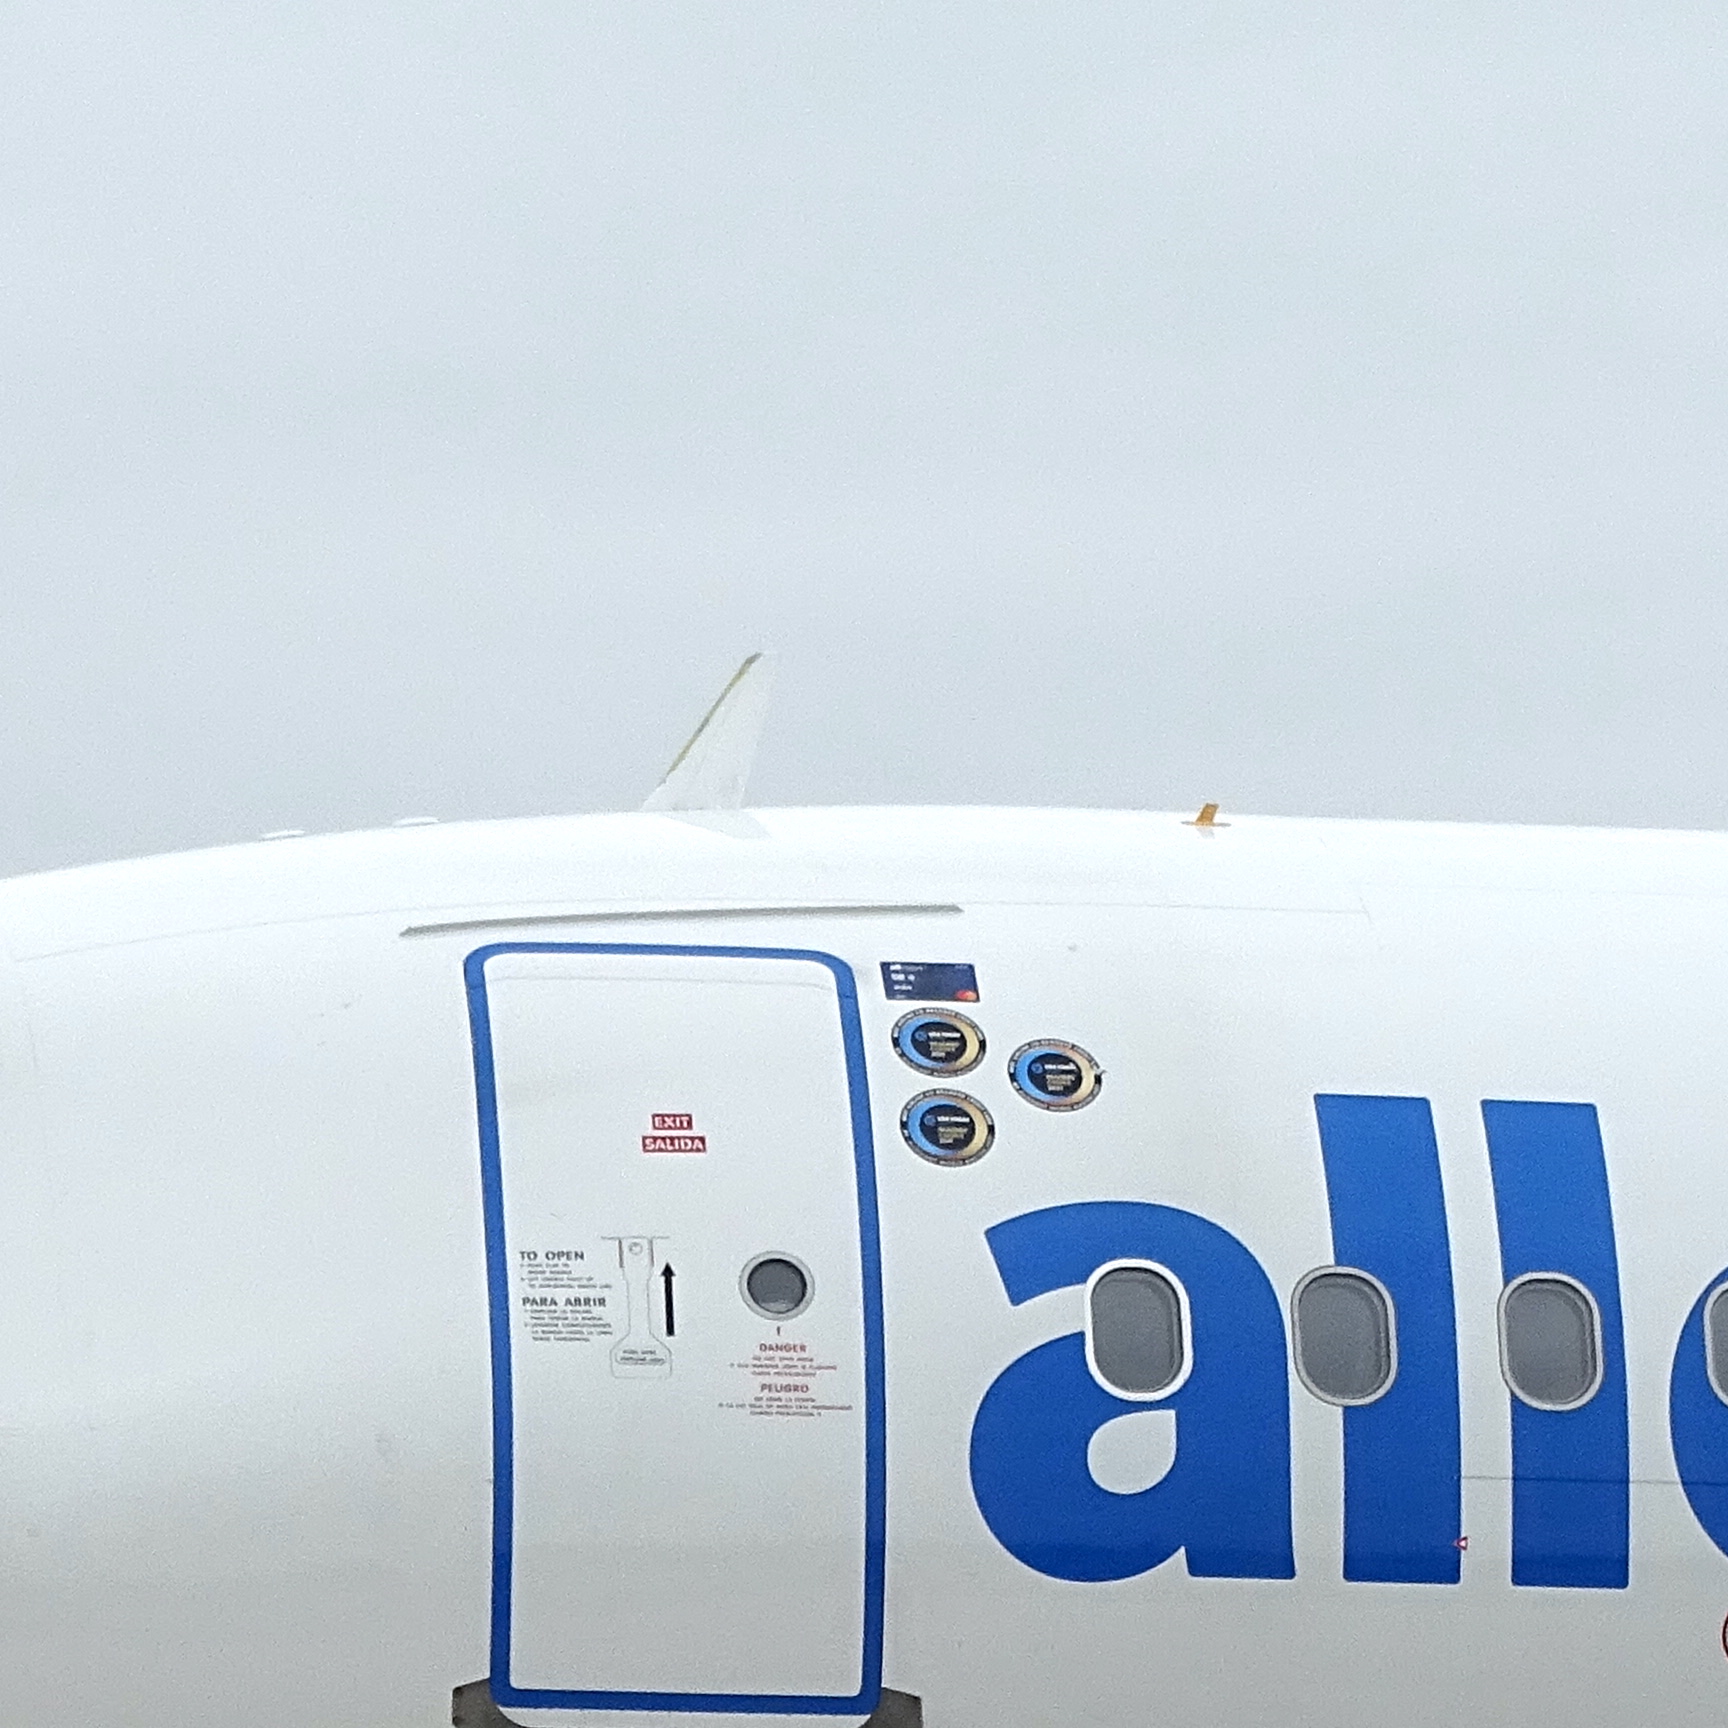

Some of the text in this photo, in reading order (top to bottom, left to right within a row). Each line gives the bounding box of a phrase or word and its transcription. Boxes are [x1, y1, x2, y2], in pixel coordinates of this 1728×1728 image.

[653, 1116, 690, 1129] EXIT
[644, 1137, 704, 1151] SALIDA
[519, 1250, 585, 1261] TO OPEN
[521, 1296, 607, 1308] PARA ABRIR
[759, 1343, 807, 1353] DANGER
